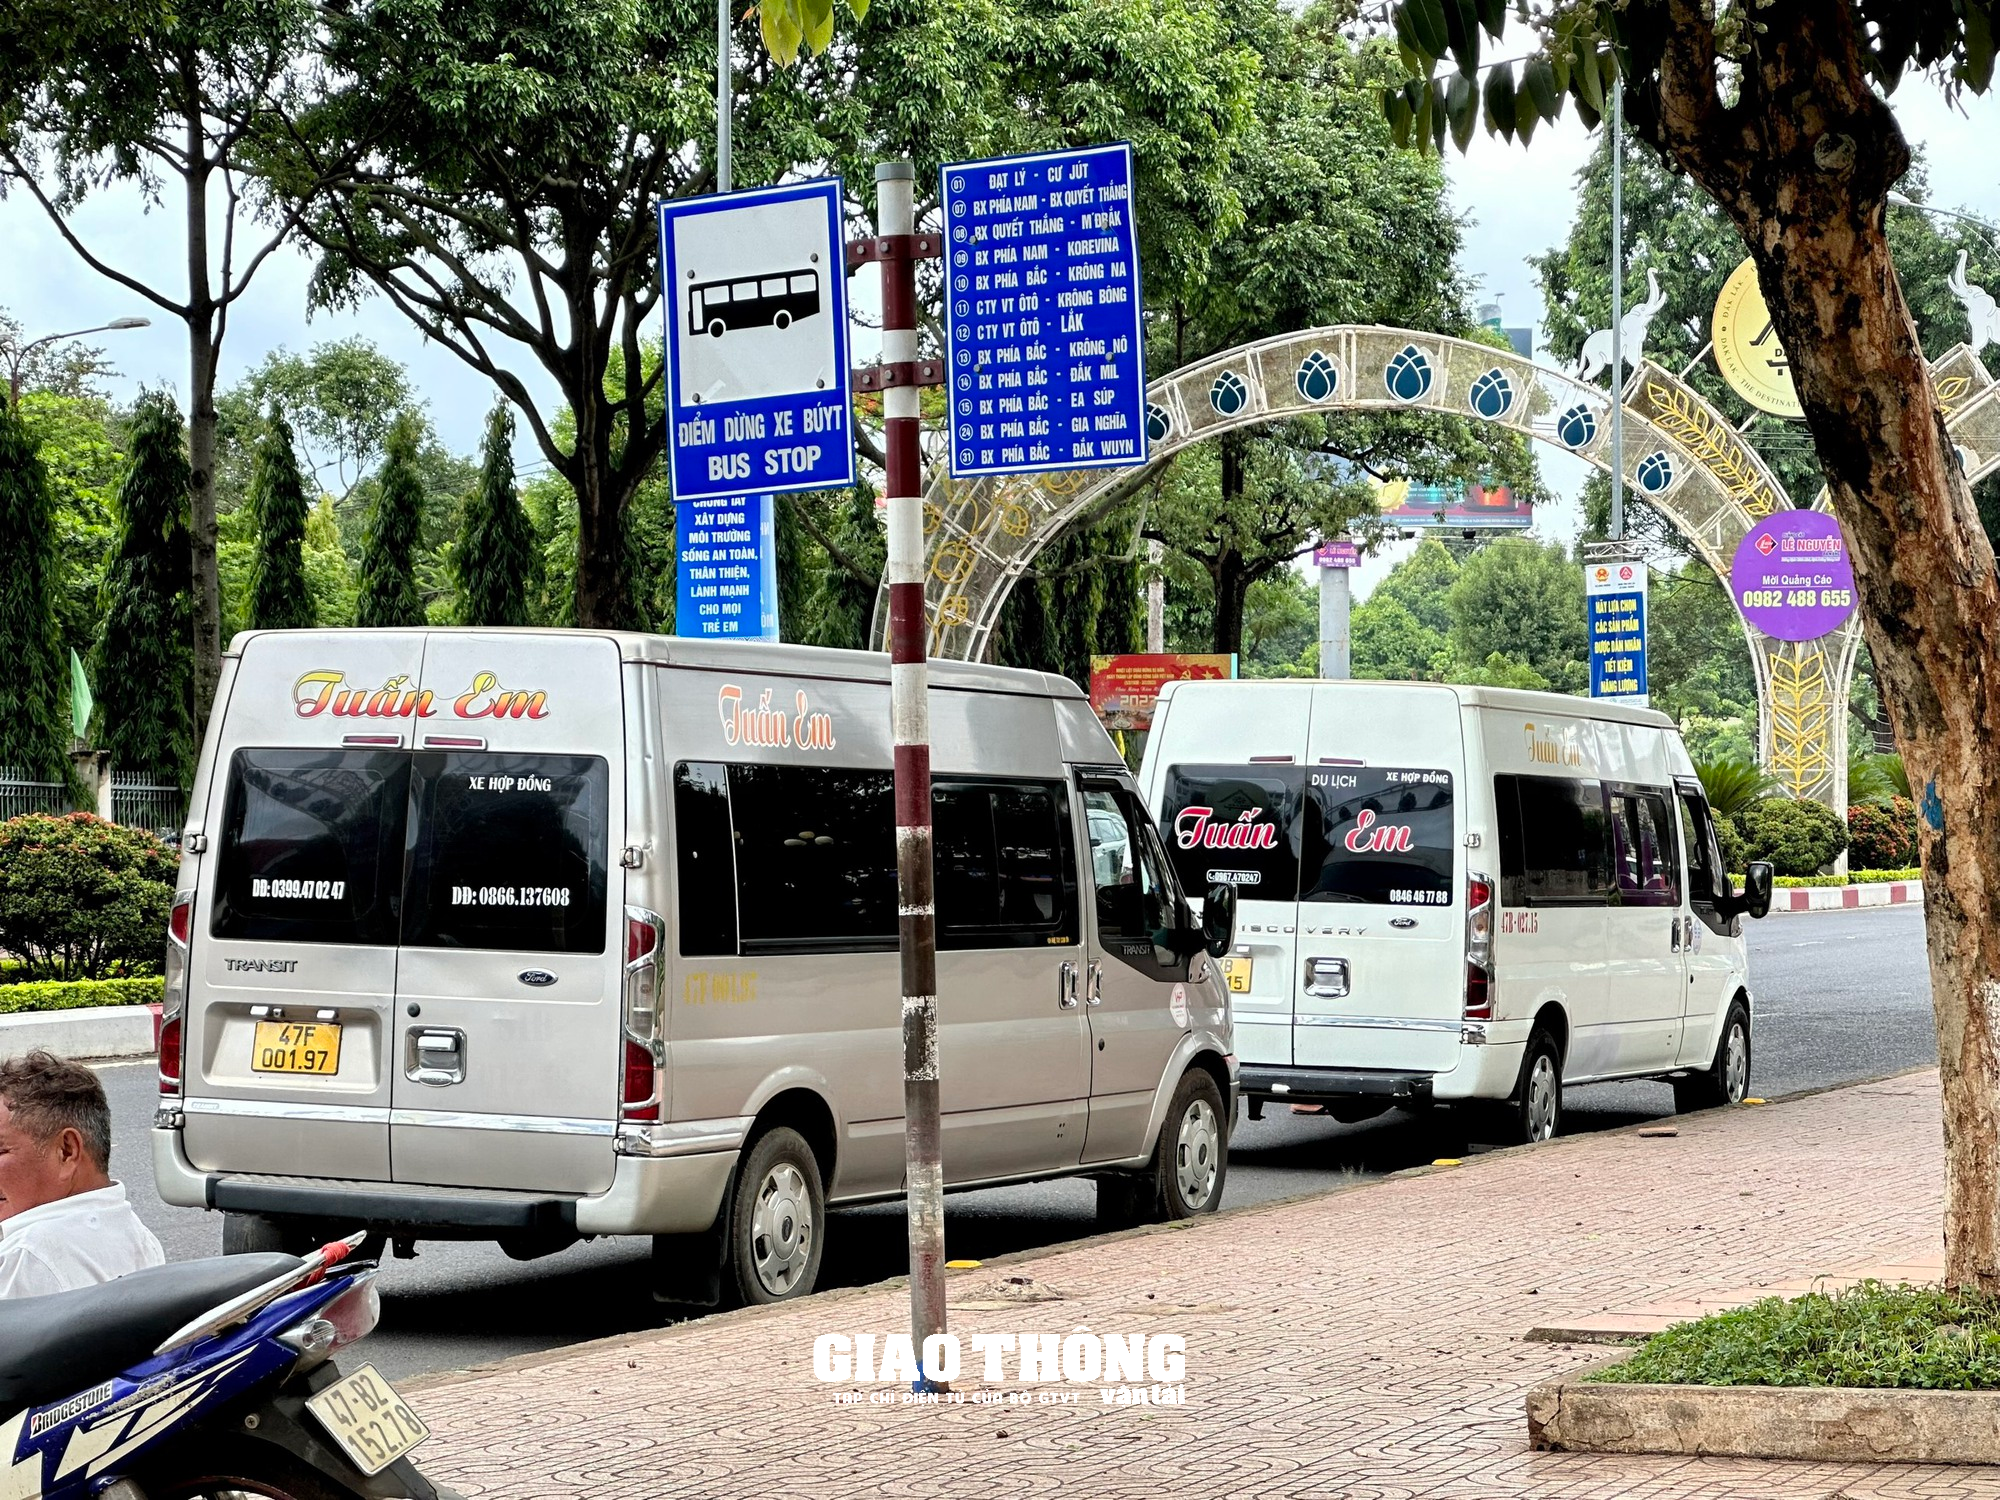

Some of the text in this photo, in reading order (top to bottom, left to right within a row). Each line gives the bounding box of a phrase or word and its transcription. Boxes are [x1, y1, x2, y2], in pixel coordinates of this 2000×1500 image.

[989, 160, 1088, 192] ĐẠT LÝ CƯ JÚT
[974, 180, 1128, 216] BX PHÍA NAM BX QUYẾT THẮNG
[974, 226, 988, 241] BX
[993, 217, 1023, 239] QUYẾT
[1030, 213, 1064, 236] THẮNG
[976, 237, 1119, 266] BX PHÍA NAM KOREVINA
[976, 262, 1126, 290] BX PHÍA BẮC KRÔNG NA
[976, 286, 1127, 314] CTY VT ÔTÔ KRÔNG BÔNG
[977, 308, 1084, 340] CTY VT ÔTÔ LẮK
[977, 335, 1128, 364] BX PHÍA BẮC KRÔNG NÔ
[979, 361, 1119, 390] BX PHÍA BẮC ĐẮK MIL
[1740, 379, 1753, 394] THE
[980, 387, 1115, 415] BX PHÍA BẮC EA SÚP
[678, 402, 843, 448] ĐIỂM DỪNG XE BÚYT
[980, 411, 1127, 440] BX PHÍA BẮC GIA NGHĨA
[981, 437, 1134, 465] BX PHÍA BẮC ĐẮK WUYN
[708, 445, 821, 481] BUS STOP
[695, 512, 745, 527] XÂY DỰNG
[689, 530, 708, 544] MÔI
[712, 528, 751, 543] TRƯỜNG
[1782, 536, 1795, 551] LÊ
[1797, 535, 1841, 551] NGUYỄN
[682, 547, 758, 562] SỐNG AN TOÀN,
[690, 565, 750, 580] THÂN THIỆN,
[1762, 574, 1832, 586] Mời Quảng Cáo
[691, 584, 749, 598] LÀNH MẠNH
[1743, 590, 1850, 607] 0982 488 655
[699, 603, 741, 616] CHO MỌI
[702, 618, 738, 633] TRẺ EM
[1595, 619, 1607, 634] CÁC
[1604, 656, 1616, 673] TIẾT
[296, 670, 549, 720] Tuấn Em
[718, 683, 836, 750] Tuấn Em
[468, 774, 551, 794] XE HỢP ĐỒNG
[1311, 774, 1357, 789] DU LỊCH
[1386, 770, 1449, 785] XE HỢP ĐỒNG
[1174, 806, 1278, 849] Tuấn
[1345, 808, 1414, 852] Em
[252, 878, 271, 897] DĐ:
[452, 886, 570, 906] DĐ: 0866.137608
[1390, 889, 1412, 902] 0846
[1436, 890, 1448, 904] 88
[1241, 924, 1368, 936] ISCOVERY
[1122, 944, 1150, 955] TRANSIT
[224, 958, 298, 974] TRANSIT
[524, 971, 548, 983] Ford
[279, 1026, 316, 1046] 47F
[262, 1048, 328, 1071] 001.97
[31, 1380, 111, 1439] BRIDGESTONE
[324, 1374, 388, 1427] 47-B2
[347, 1404, 422, 1466] 152.78
